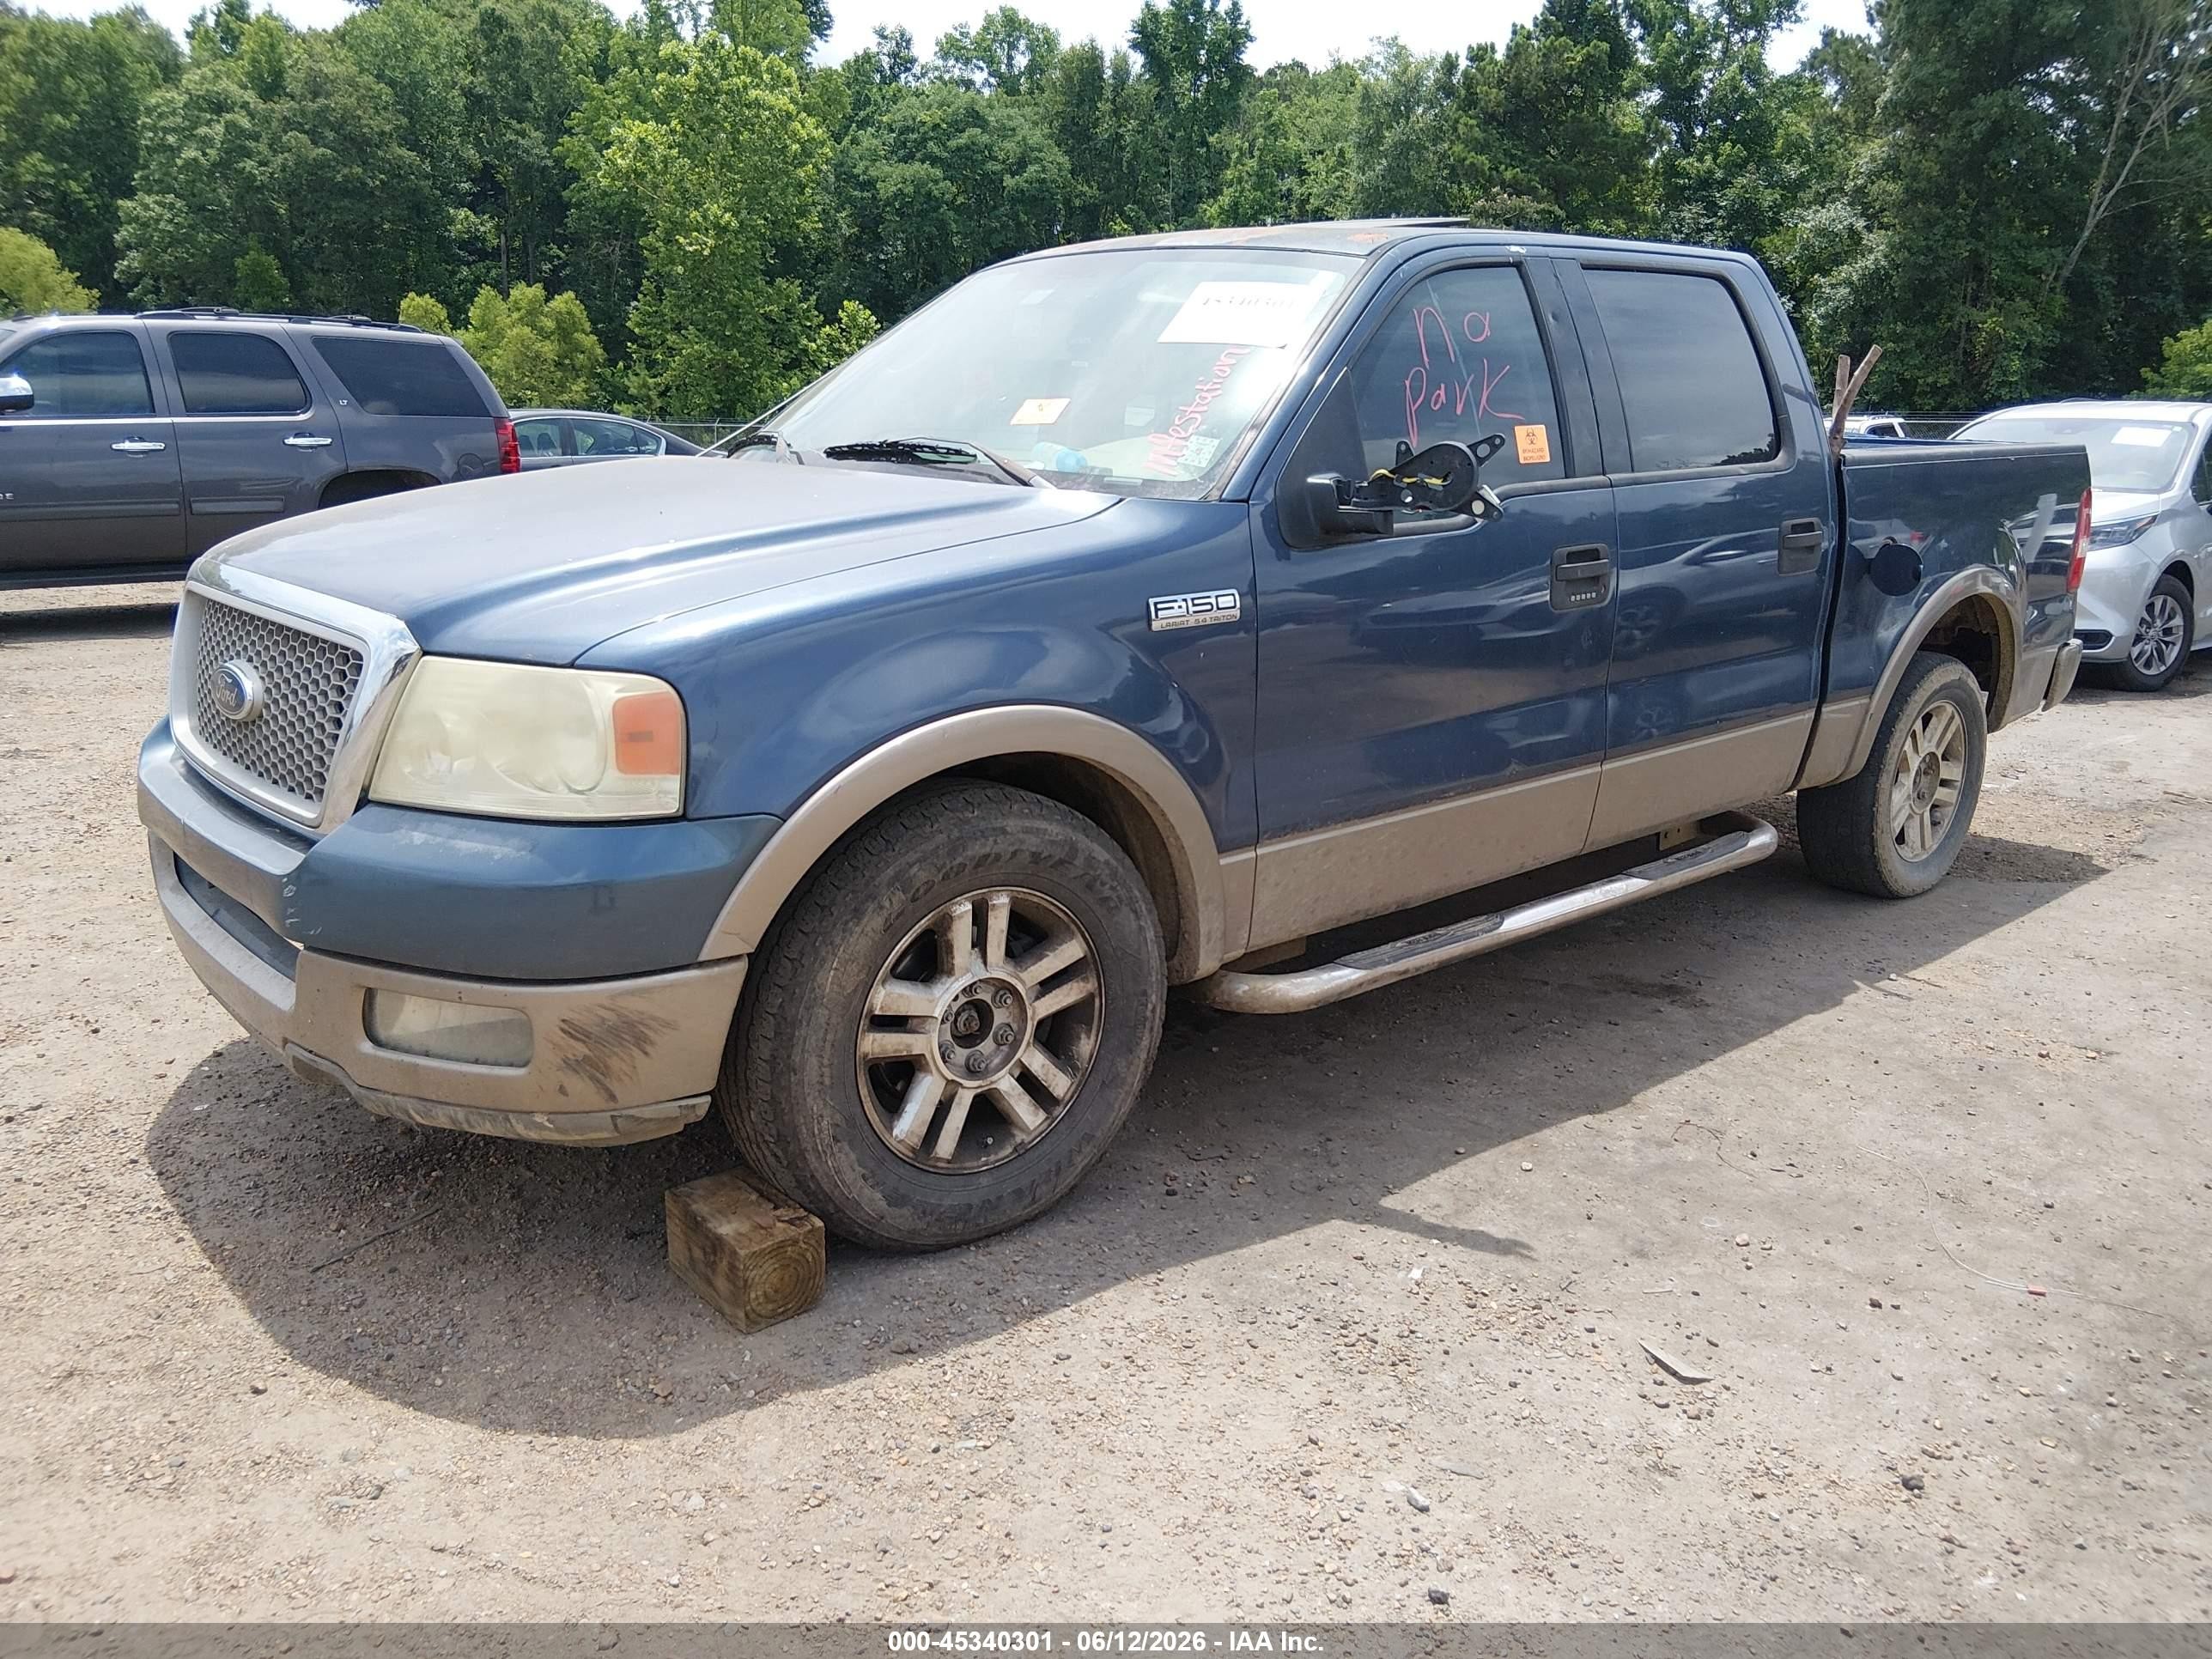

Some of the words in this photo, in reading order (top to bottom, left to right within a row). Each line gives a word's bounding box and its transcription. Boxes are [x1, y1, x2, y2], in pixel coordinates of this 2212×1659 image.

[1160, 619, 1190, 629] LARIAT
[1209, 613, 1237, 622] TRITON
[216, 672, 239, 708] Ford
